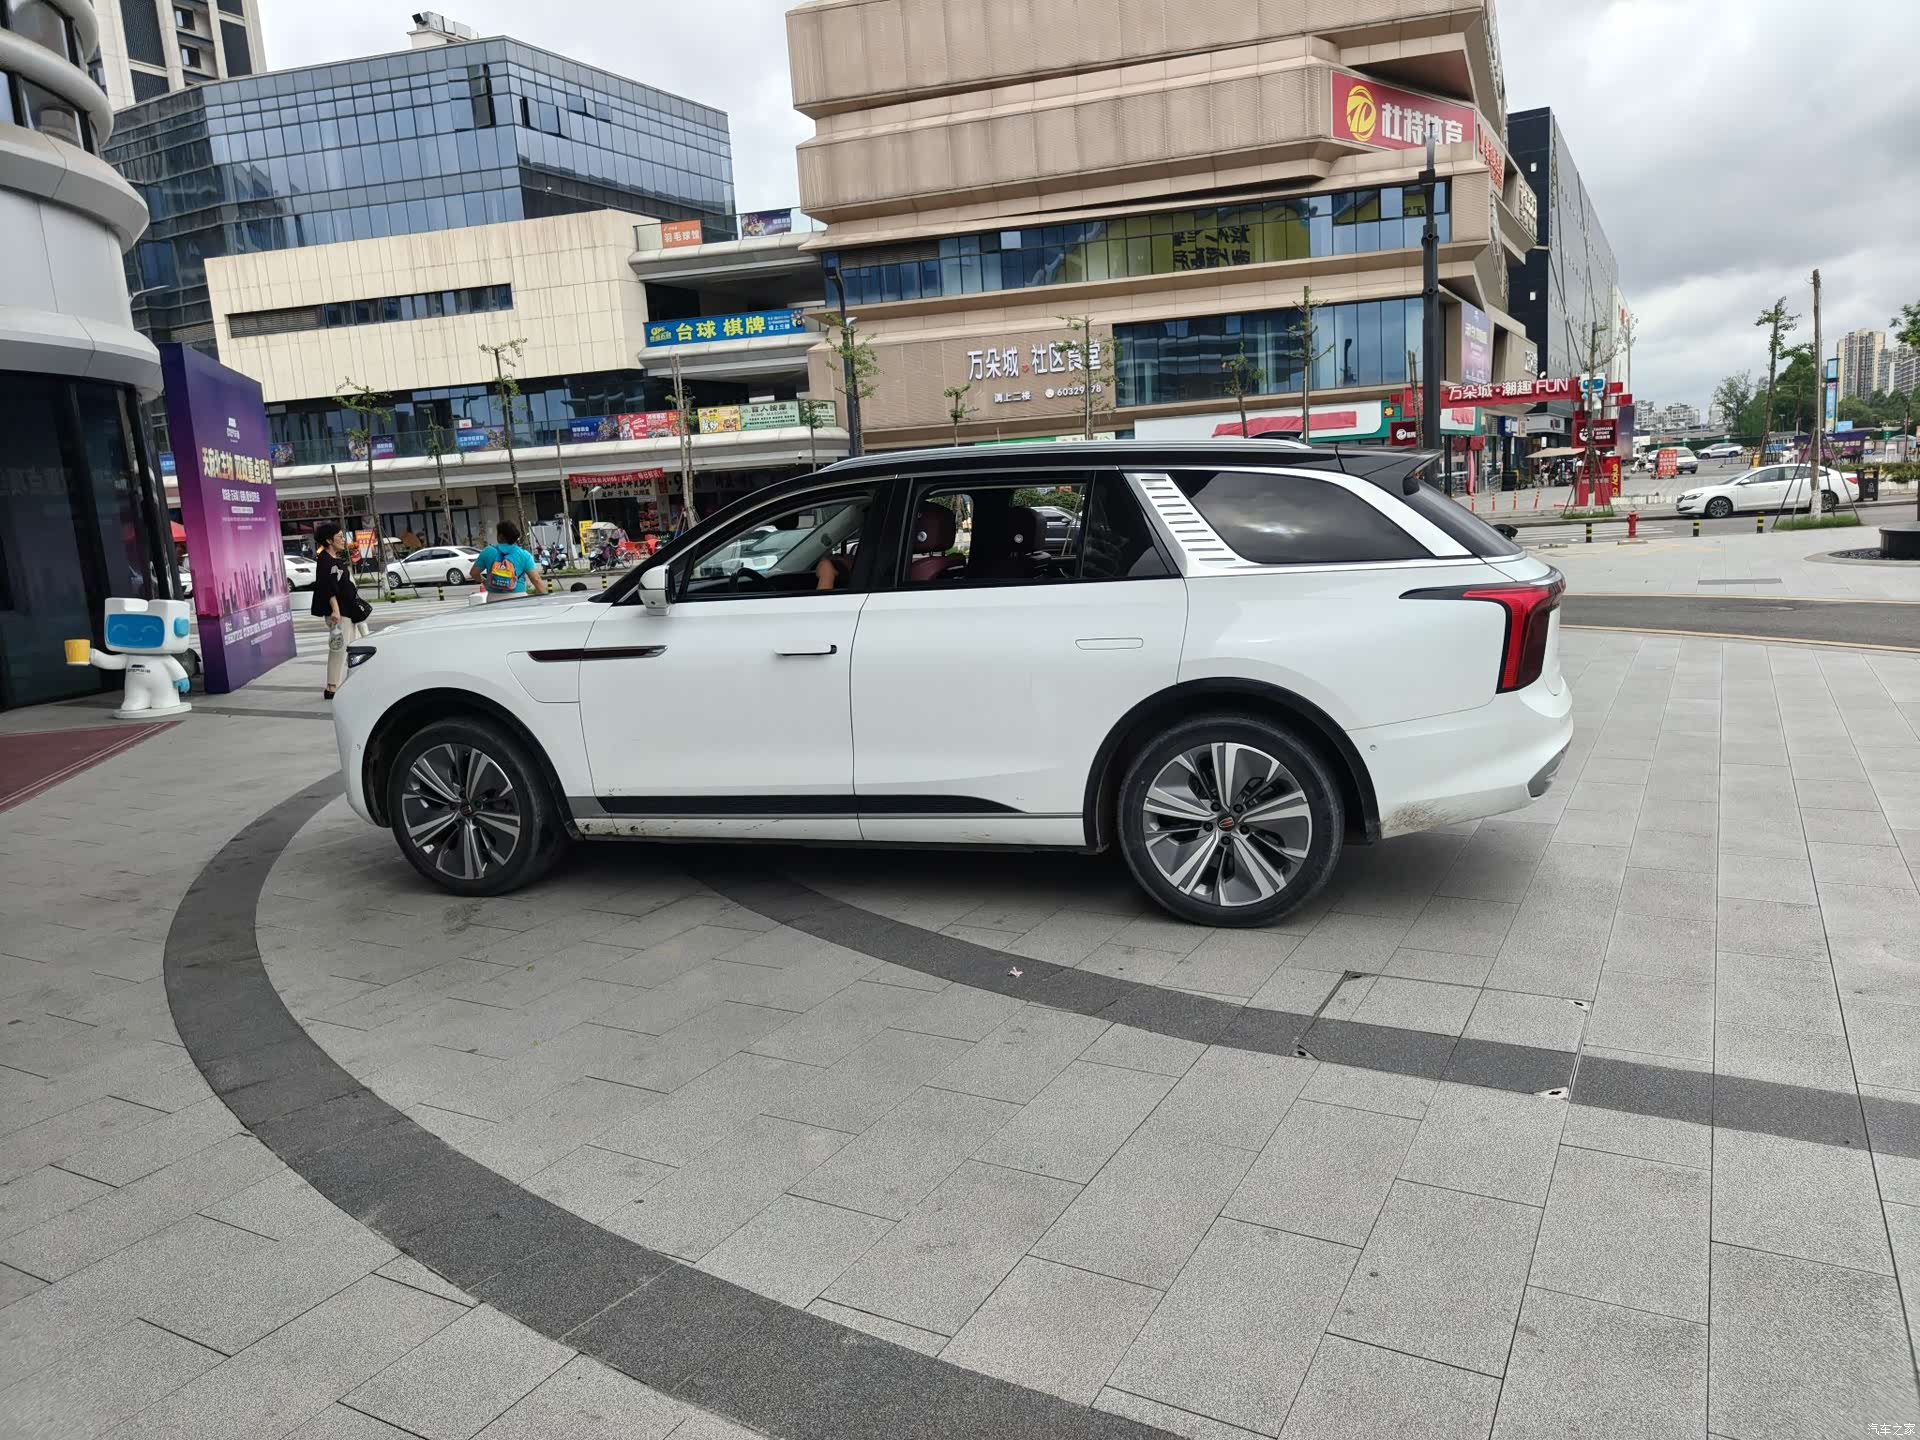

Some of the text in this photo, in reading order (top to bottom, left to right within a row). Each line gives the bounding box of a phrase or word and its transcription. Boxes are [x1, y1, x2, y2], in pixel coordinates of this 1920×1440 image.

[1382, 102, 1464, 145] 杜特体育
[664, 230, 700, 242] 羽毛球馆
[676, 320, 716, 342] 台球
[723, 316, 766, 337] 棋牌
[968, 338, 1102, 380] 万朵城 社区食堂
[1057, 384, 1102, 396] 6032978
[1536, 378, 1568, 394] FUN
